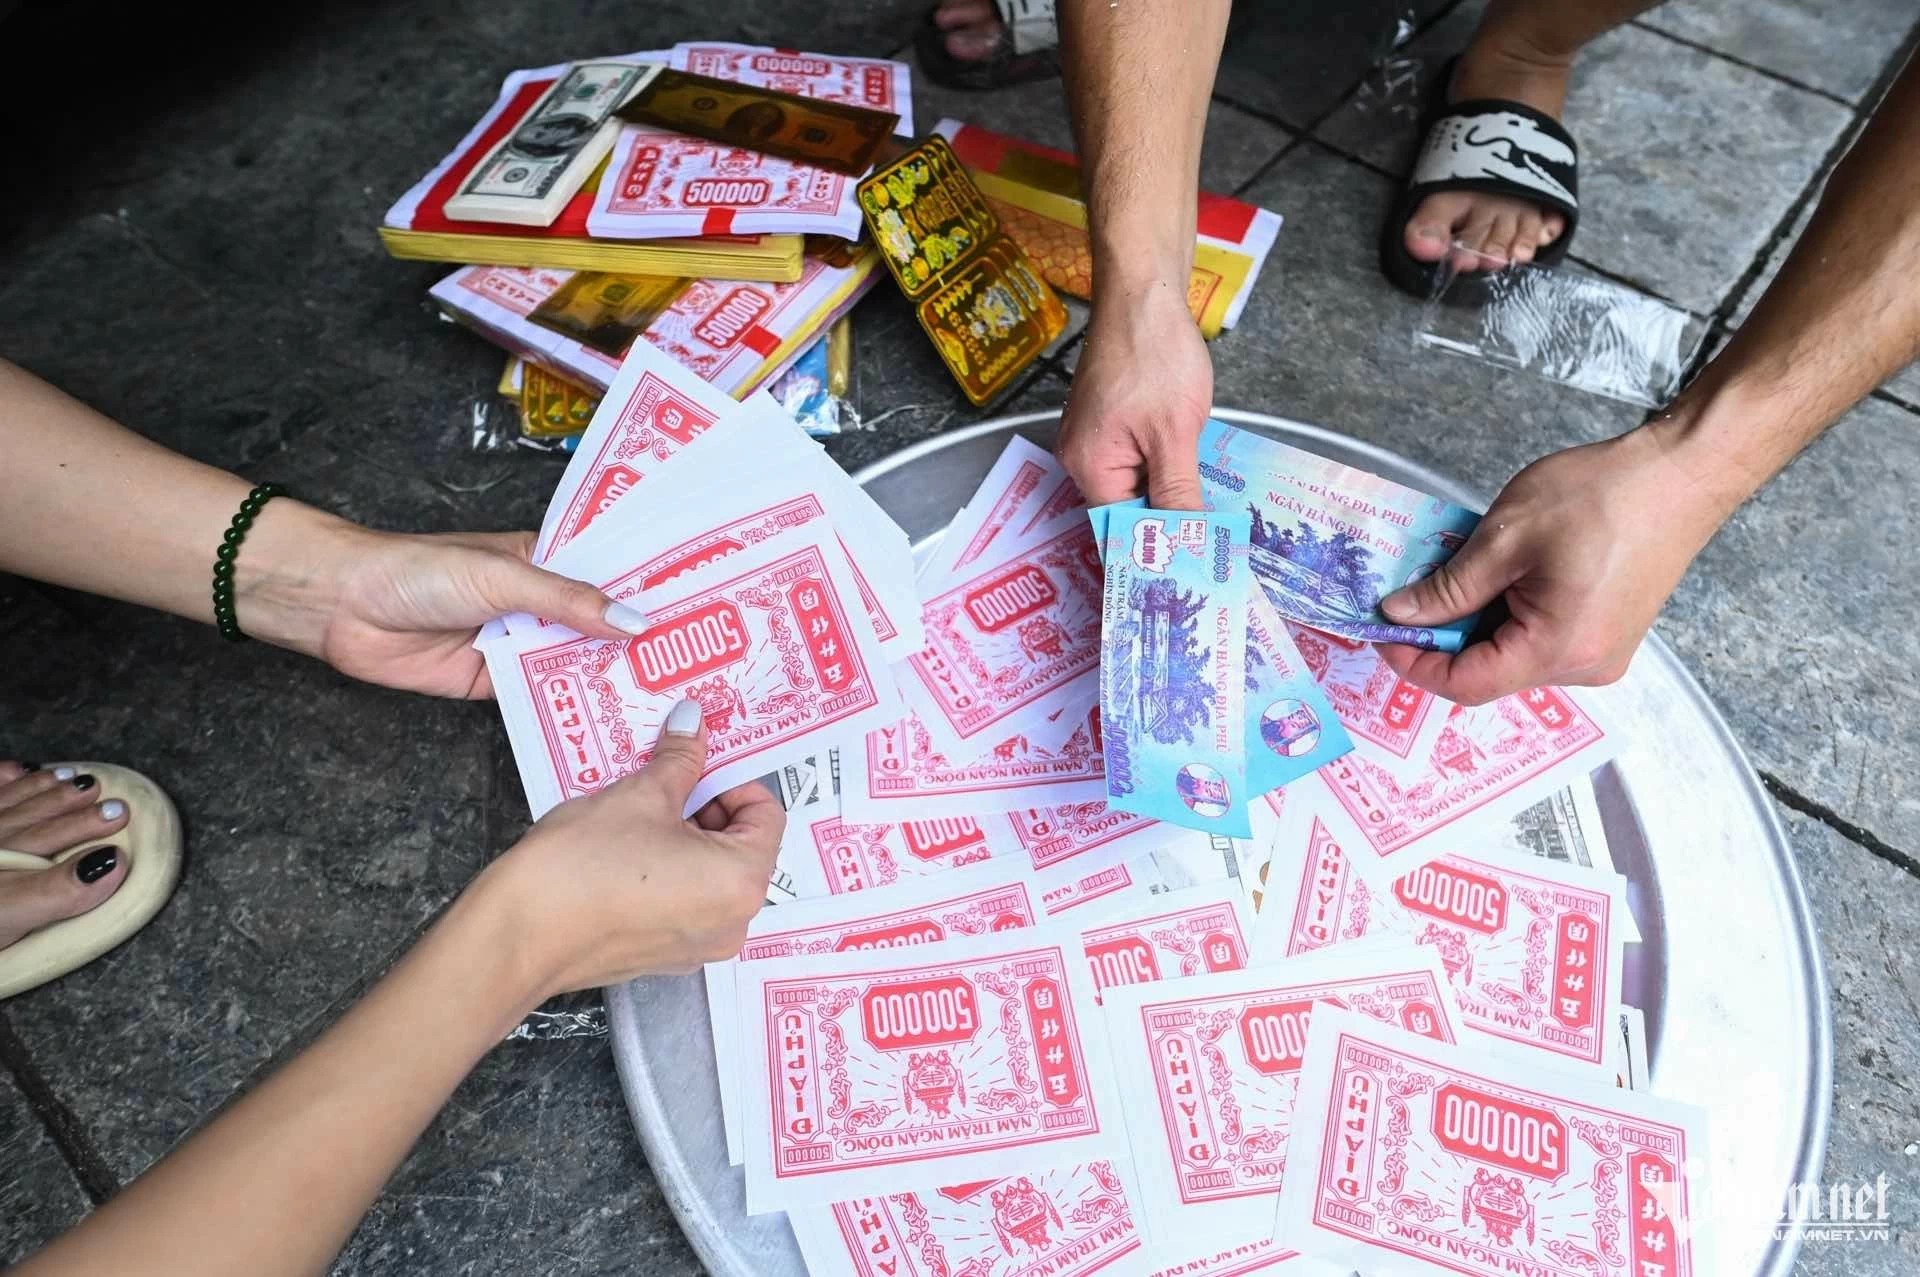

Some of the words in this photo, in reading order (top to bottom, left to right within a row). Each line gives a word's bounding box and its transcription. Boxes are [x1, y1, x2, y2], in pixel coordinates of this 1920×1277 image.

[896, 1124, 943, 1149] NGÀN
[947, 1120, 993, 1142] TRĂM
[996, 1116, 1032, 1138] NĂM
[843, 1135, 894, 1157] ĐỒNG
[1099, 1217, 1135, 1244] NĂM
[1386, 1220, 1442, 1250] ĐỒNG
[1054, 1236, 1099, 1269] TRĂM
[1446, 1239, 1500, 1269] NGÀN
